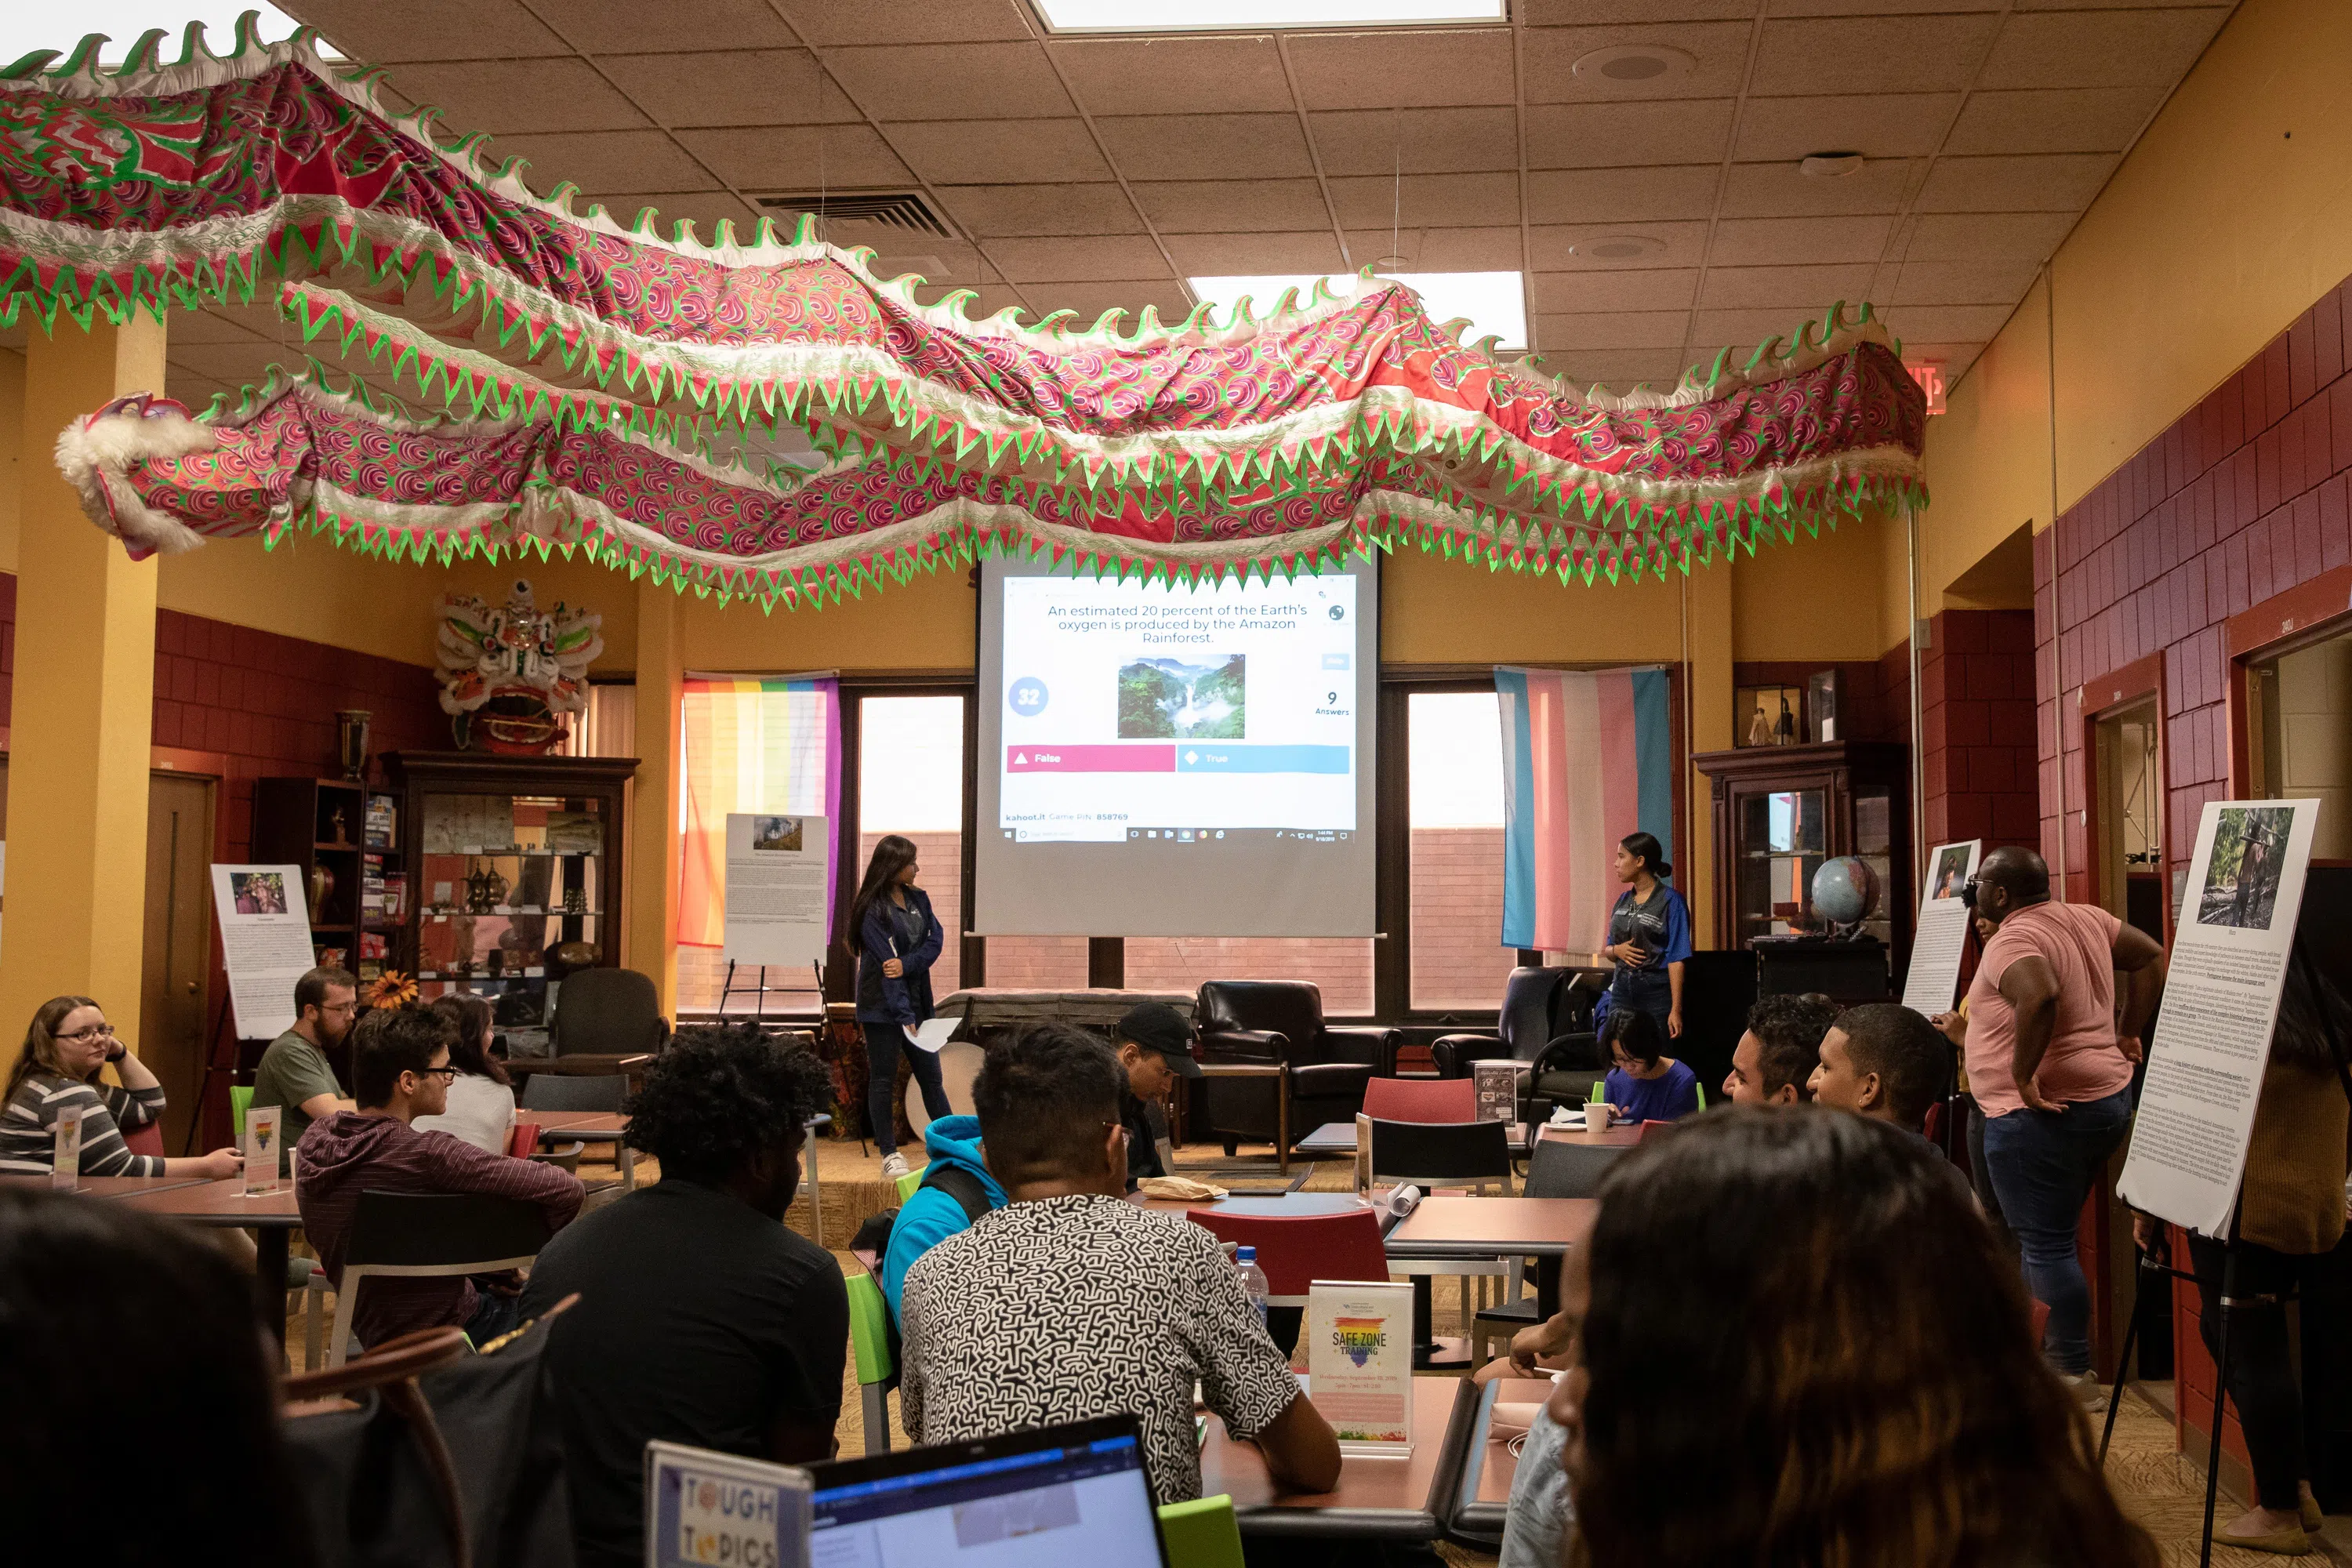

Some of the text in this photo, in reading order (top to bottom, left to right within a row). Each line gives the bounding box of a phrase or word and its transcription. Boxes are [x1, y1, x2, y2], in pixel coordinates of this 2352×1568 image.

[1048, 604, 1307, 618] An estimated 20 percent of the Earth's
[1058, 619, 1296, 632] oxygen is produced by the Amazon
[1143, 632, 1214, 643] Rainforest.
[1018, 689, 1040, 705] 32
[1328, 691, 1337, 705] 9
[1034, 753, 1061, 763] False
[1206, 753, 1228, 763] True
[1333, 1332, 1387, 1347] SAFE ZONE
[1340, 1346, 1378, 1356] TRAINING
